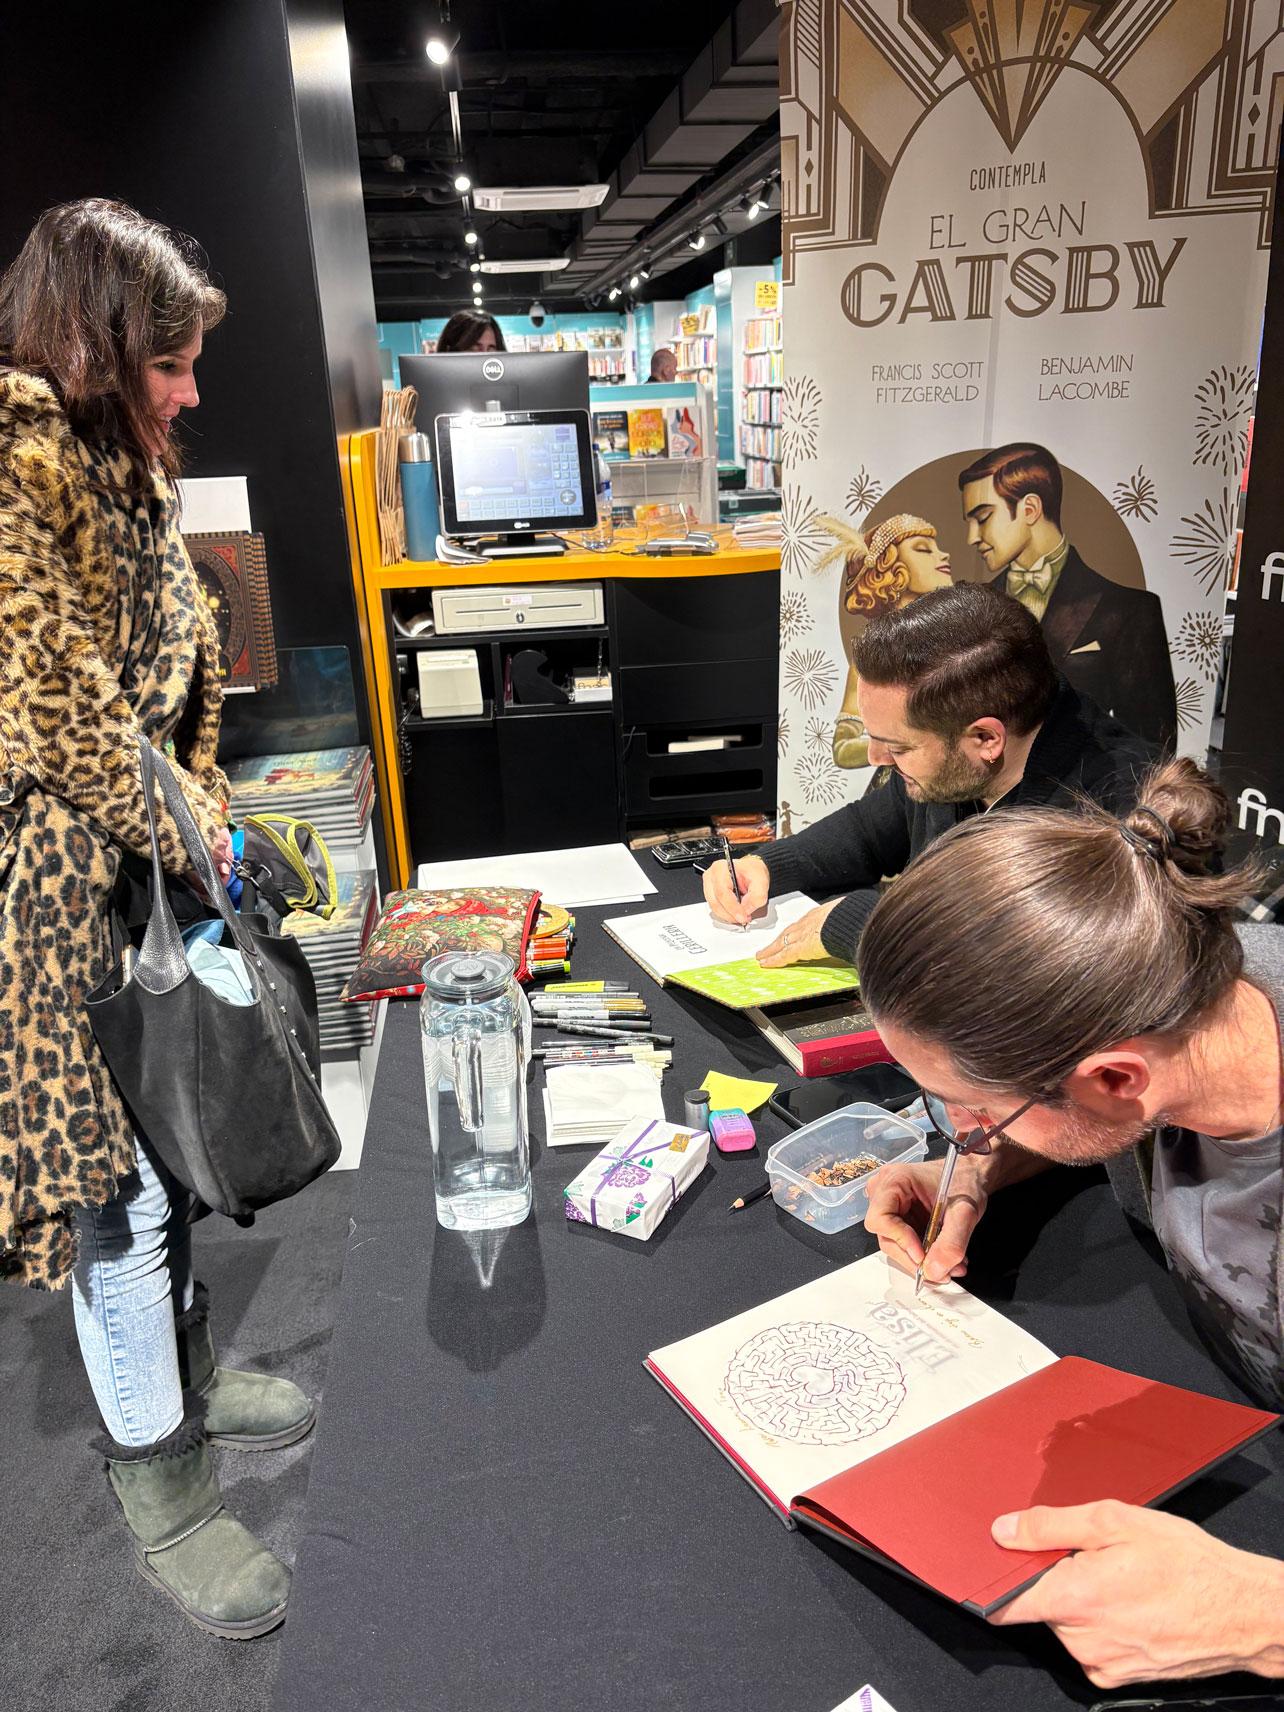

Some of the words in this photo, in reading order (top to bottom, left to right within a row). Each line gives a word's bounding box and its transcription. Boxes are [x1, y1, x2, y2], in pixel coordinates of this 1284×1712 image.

[969, 161, 1047, 192] CONTEMPLA
[929, 214, 967, 250] EL
[982, 201, 1087, 244] GRAN
[840, 236, 1188, 328] GATSBY
[871, 362, 923, 382] FRANCIS
[931, 361, 984, 380] SCOTT
[1040, 353, 1134, 376] BENJAMIN
[875, 384, 980, 404] FITZGERALD
[1038, 380, 1130, 402] LACOMBE
